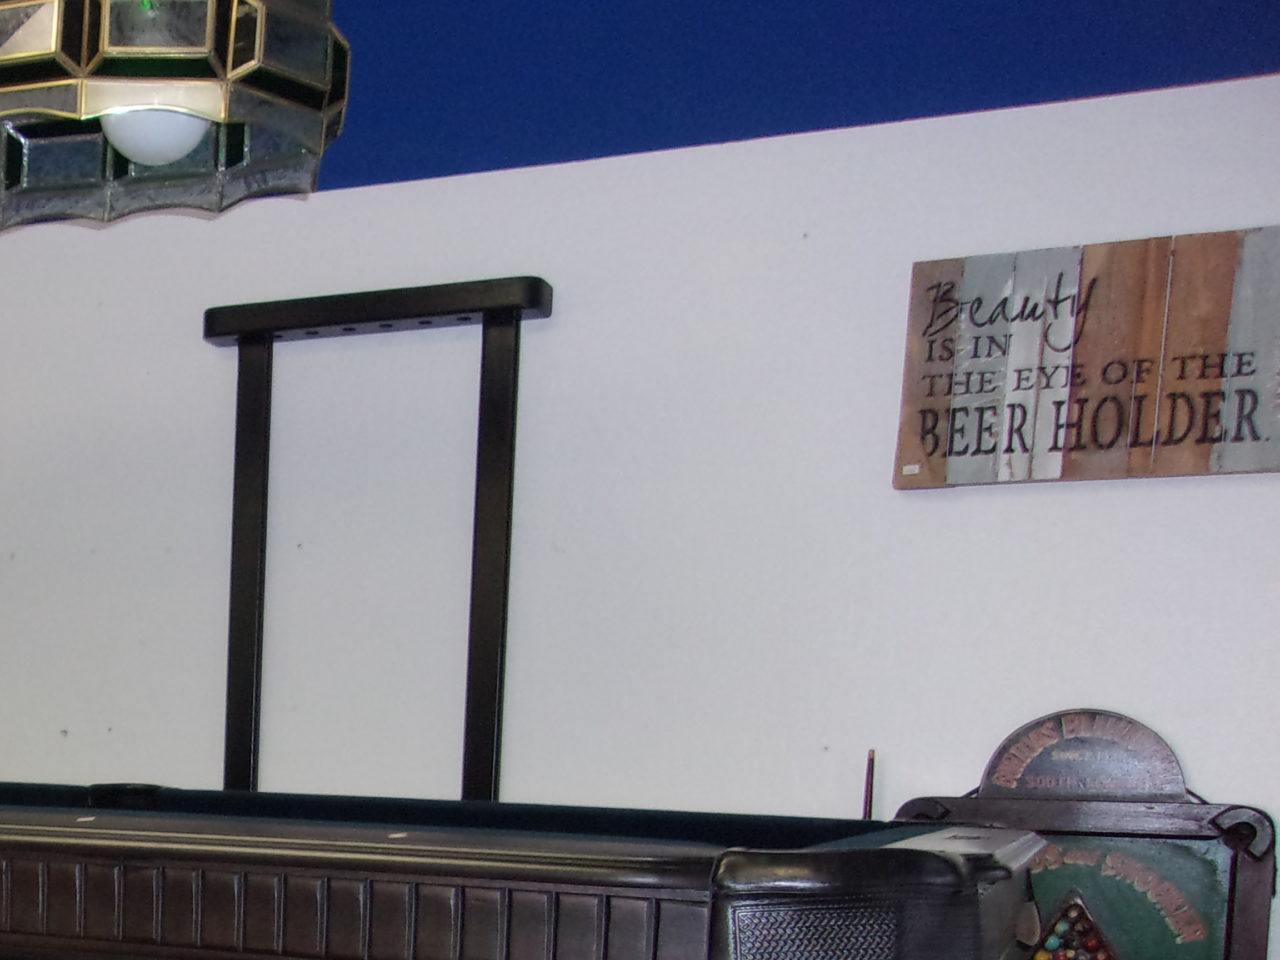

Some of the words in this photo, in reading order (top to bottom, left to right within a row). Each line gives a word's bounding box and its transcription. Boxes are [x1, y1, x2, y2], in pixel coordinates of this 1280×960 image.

[922, 272, 1097, 351] Beauty
[926, 338, 955, 363] IS
[970, 334, 1012, 359] IN
[922, 371, 998, 397] THE
[1013, 363, 1086, 391] EYE
[1101, 359, 1155, 385] OF
[1172, 352, 1256, 380] THE
[920, 403, 1029, 458] BEER
